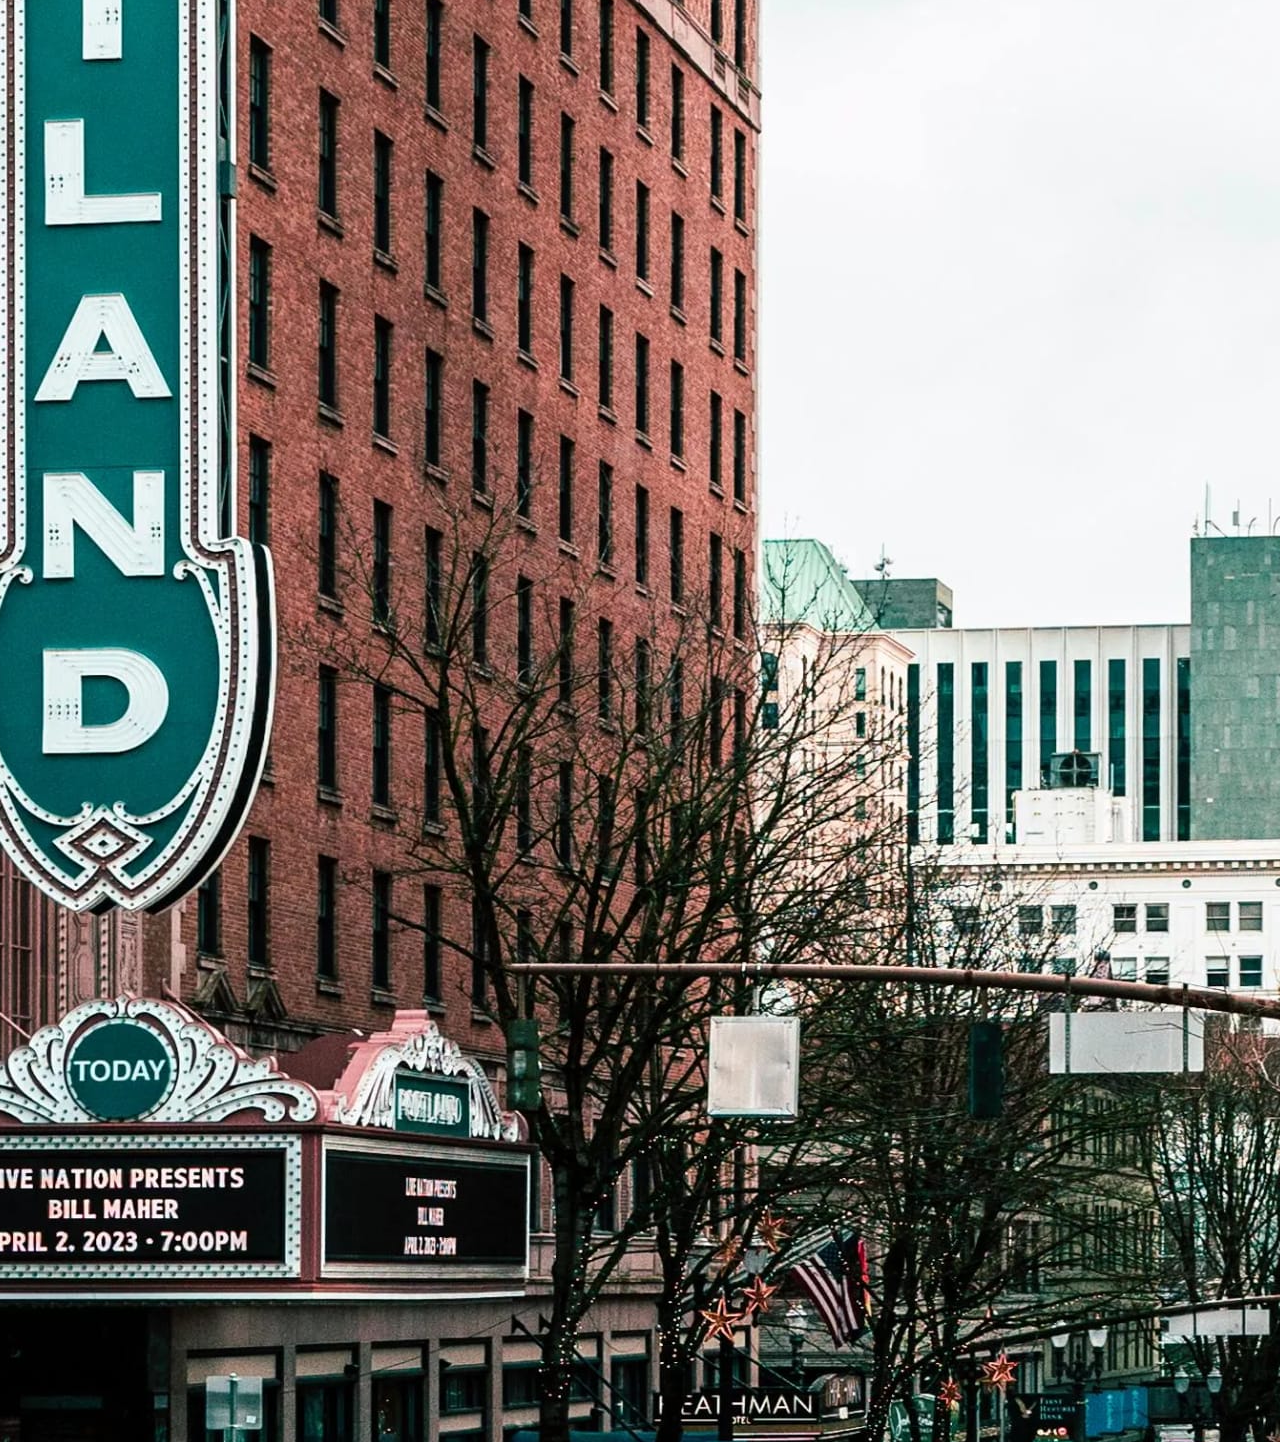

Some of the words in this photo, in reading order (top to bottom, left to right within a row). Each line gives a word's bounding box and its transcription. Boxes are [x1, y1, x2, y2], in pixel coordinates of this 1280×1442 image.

[73, 1057, 166, 1083] TODAY
[40, 1168, 123, 1189] NATION
[129, 1167, 245, 1189] PRESENTS
[48, 1199, 96, 1219] BILL
[103, 1198, 179, 1219] MAHER
[82, 1231, 138, 1252] 2023
[161, 1231, 247, 1252] 7:00PM
[732, 1415, 752, 1425] OTEL
